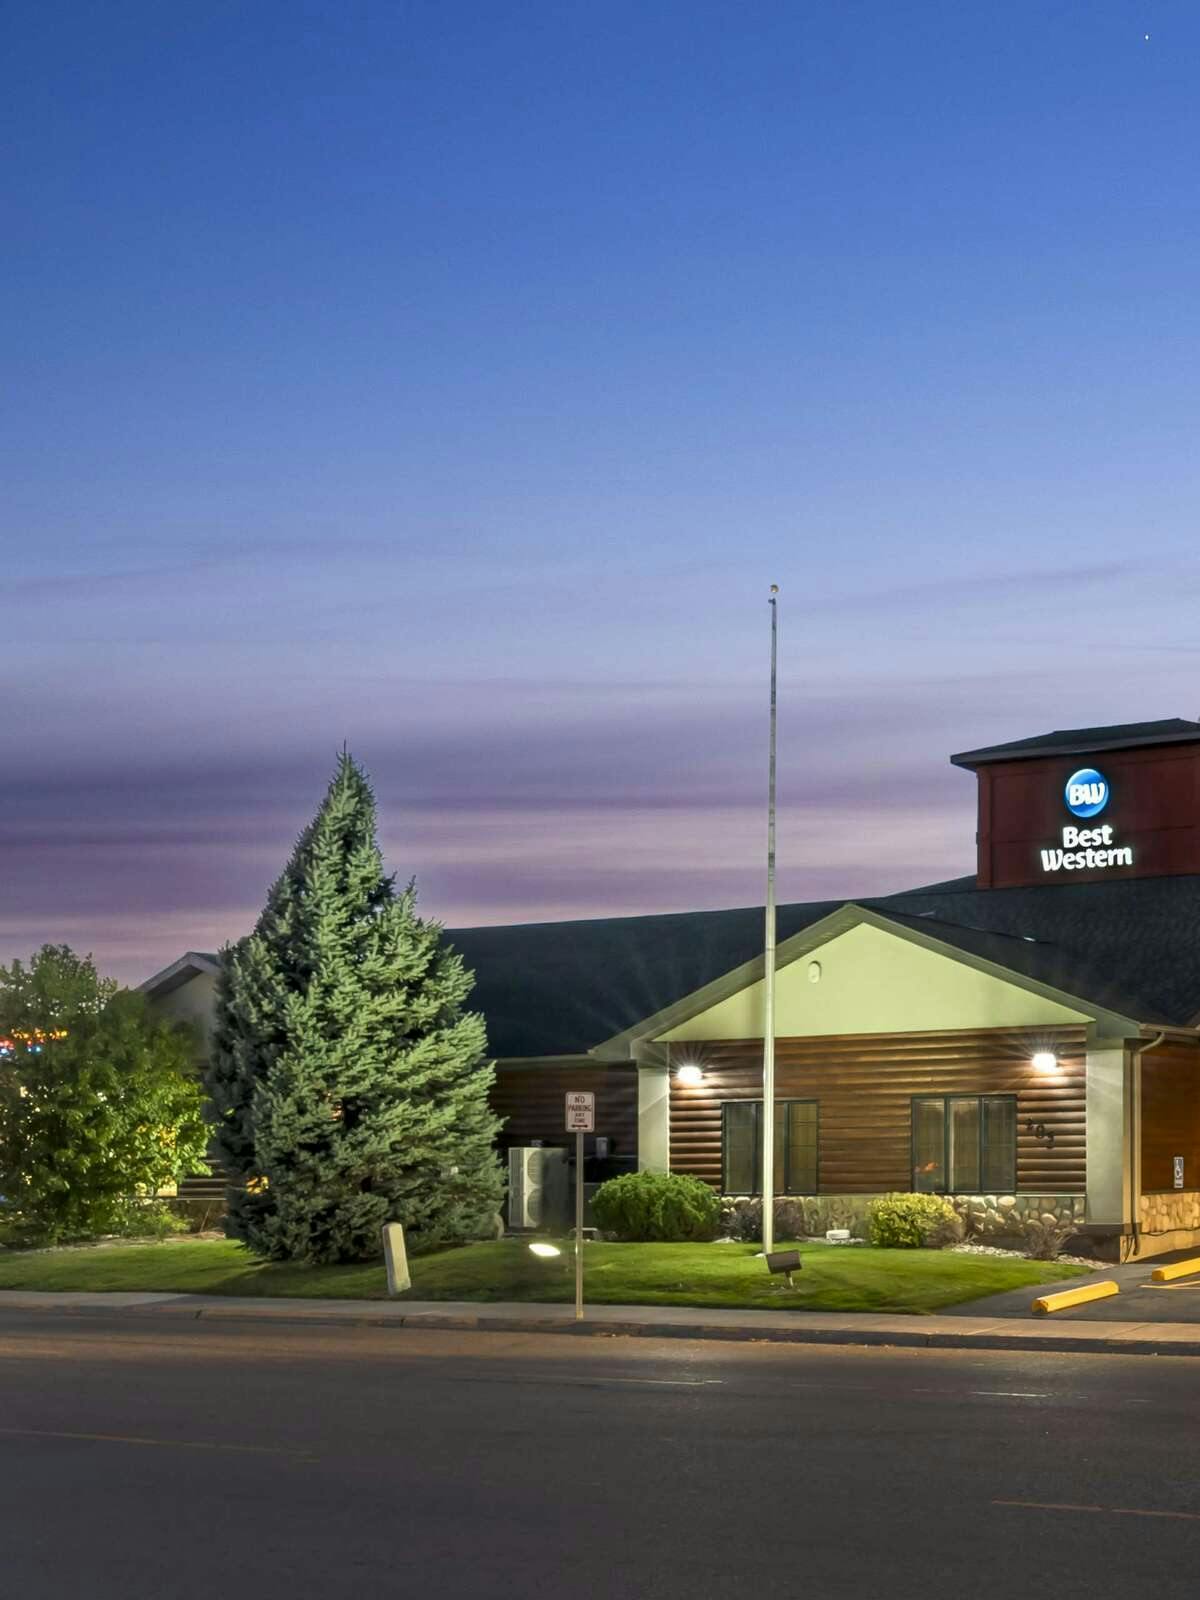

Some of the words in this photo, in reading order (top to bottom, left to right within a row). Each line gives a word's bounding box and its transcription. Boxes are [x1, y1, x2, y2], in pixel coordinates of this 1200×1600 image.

[1069, 782, 1105, 806] BW
[1062, 825, 1113, 848] Best
[1040, 847, 1133, 872] Western
[574, 1095, 586, 1104] NO
